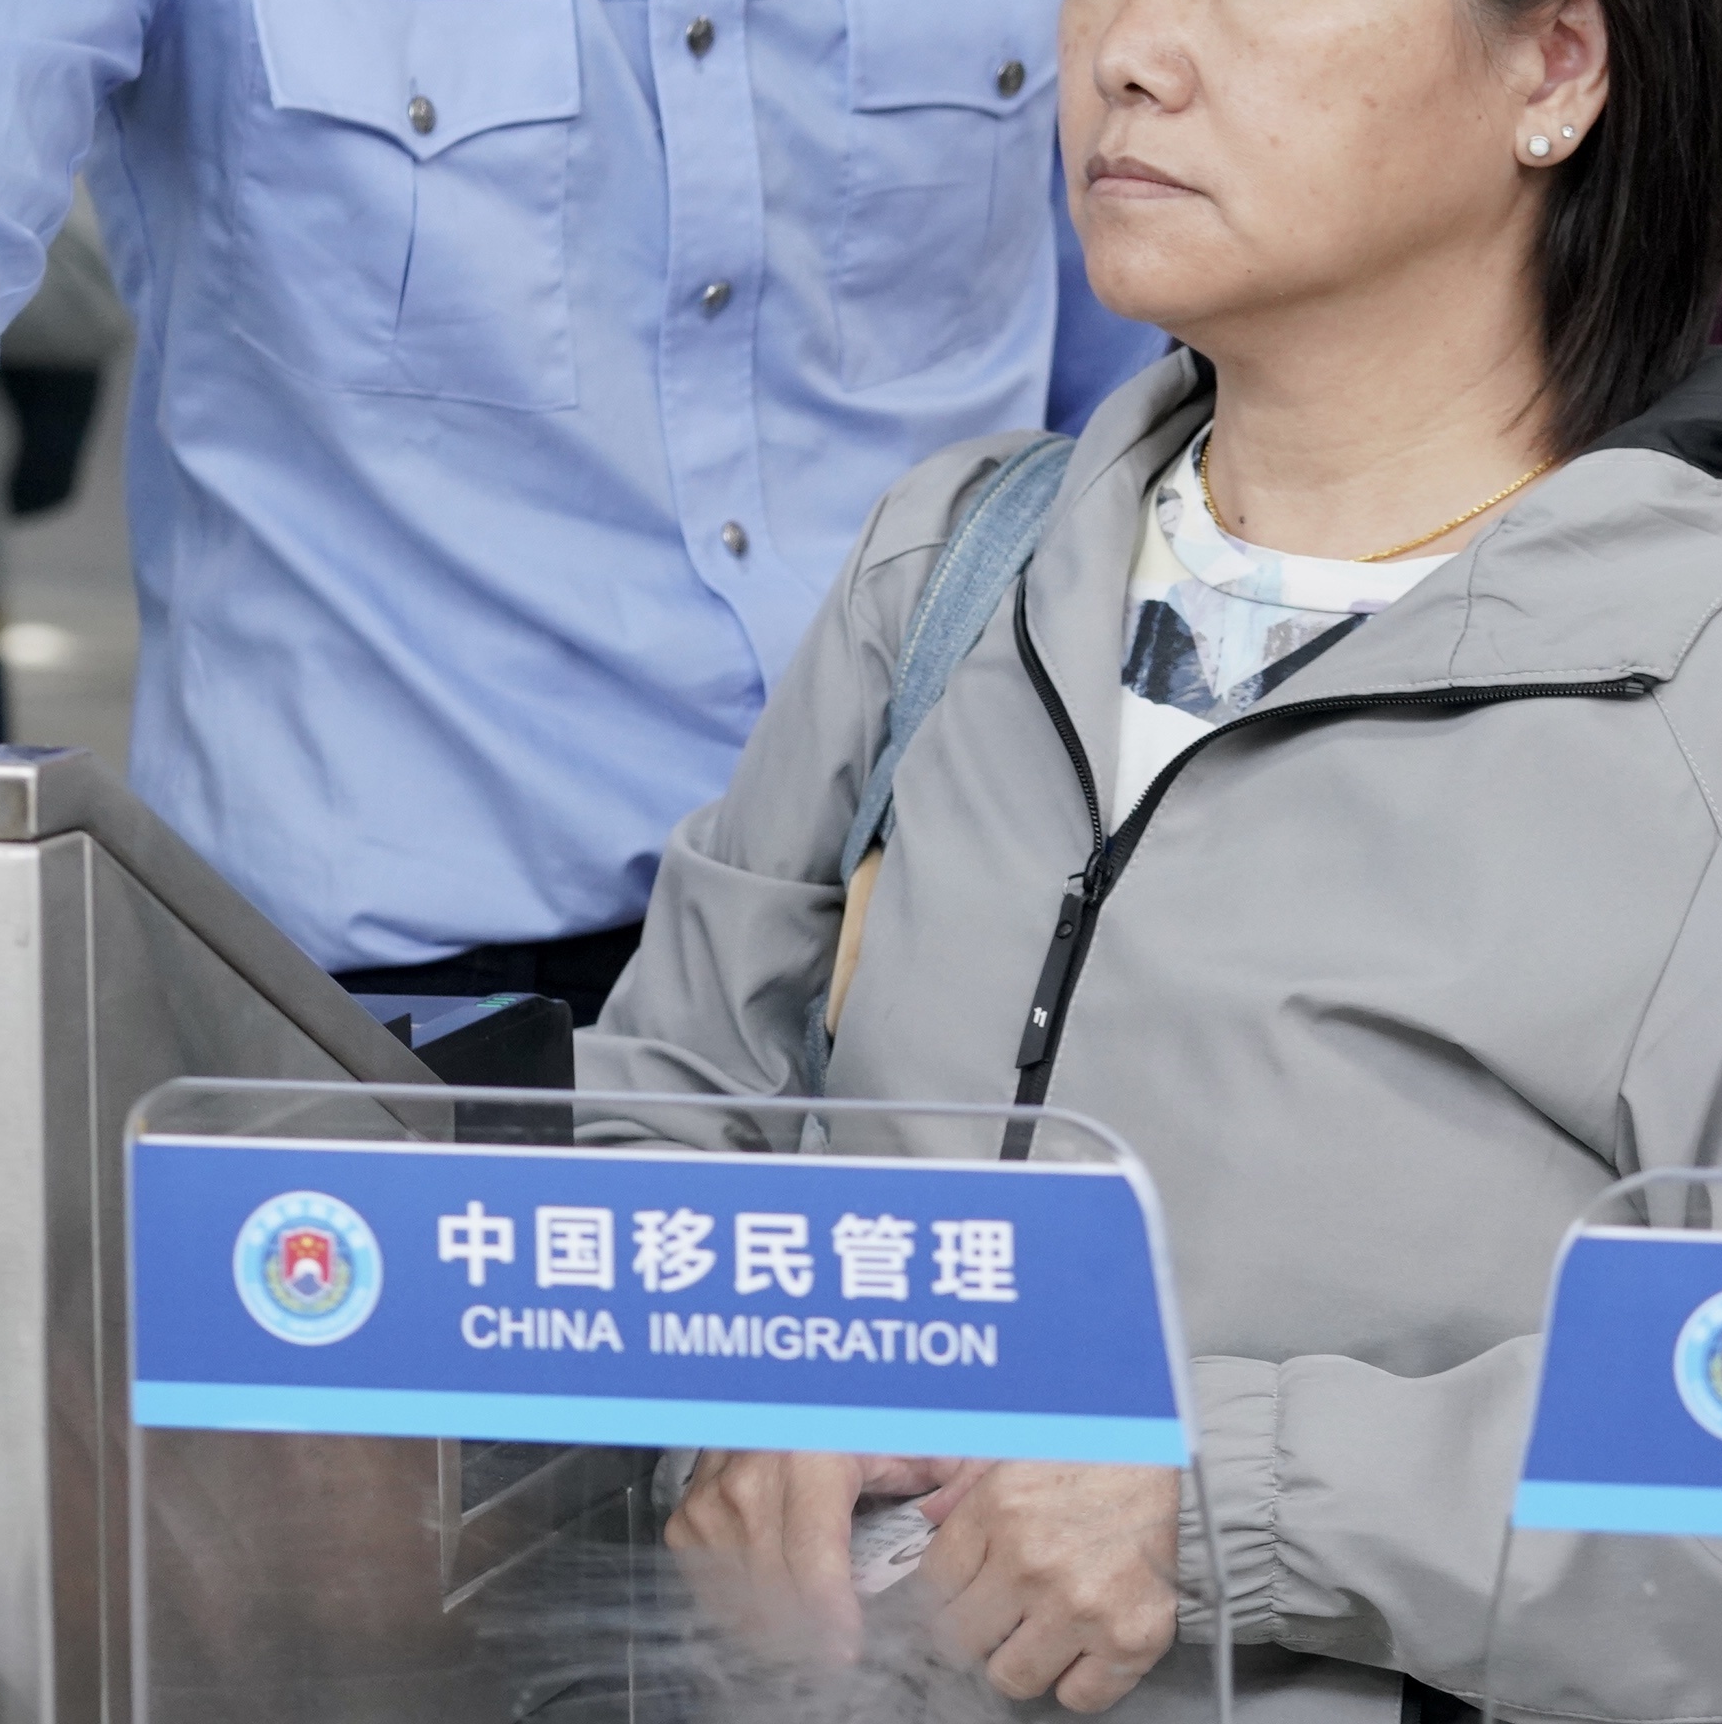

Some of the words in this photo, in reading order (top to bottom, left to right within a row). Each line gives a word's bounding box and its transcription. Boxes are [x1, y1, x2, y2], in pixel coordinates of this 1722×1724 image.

[437, 1200, 1019, 1304] 中国移民管理
[461, 1304, 625, 1353] CHINA
[648, 1312, 998, 1367] IMMIGRATION
